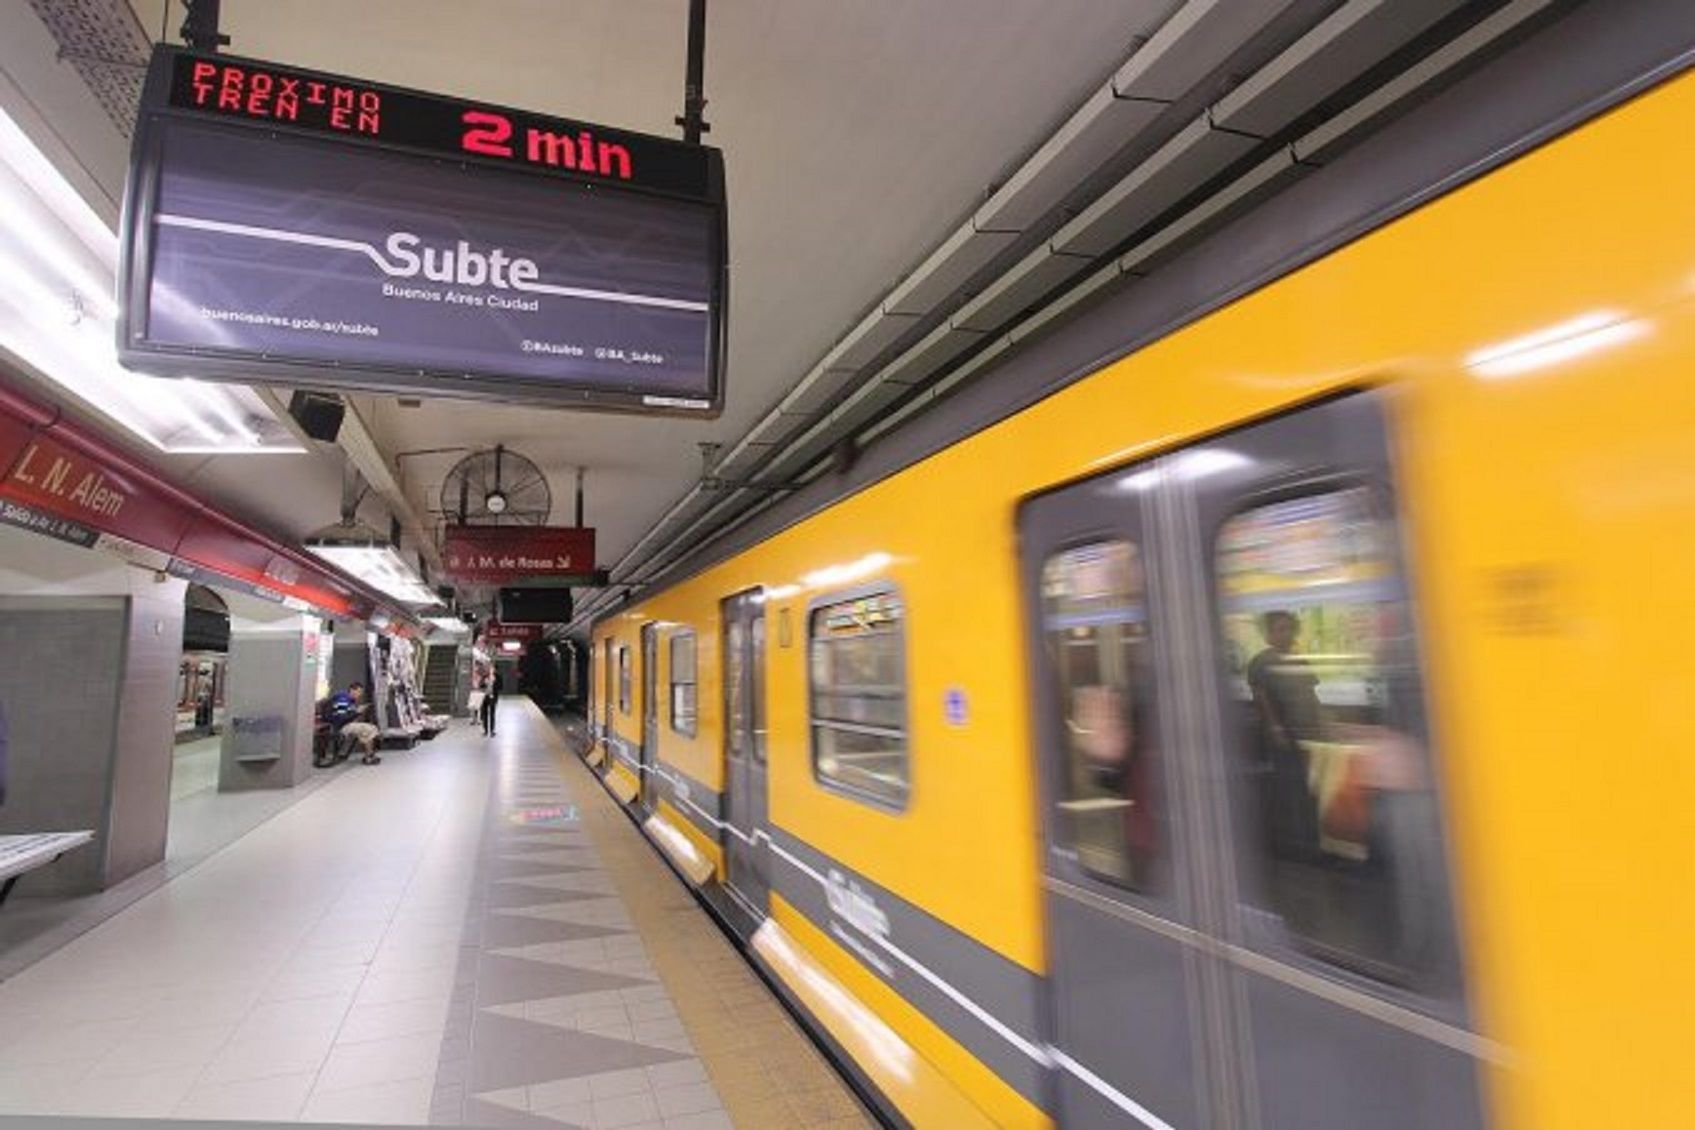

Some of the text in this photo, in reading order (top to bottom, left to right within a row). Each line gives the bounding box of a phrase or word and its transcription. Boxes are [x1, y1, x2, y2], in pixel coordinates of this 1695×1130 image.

[193, 62, 381, 113] PROXIMO
[193, 83, 380, 134] TREN EN
[461, 111, 633, 179] 2 min
[386, 232, 540, 292] Subte
[382, 283, 539, 311] Buenos Aires Ciudad
[14, 445, 125, 517] L. N. Alem
